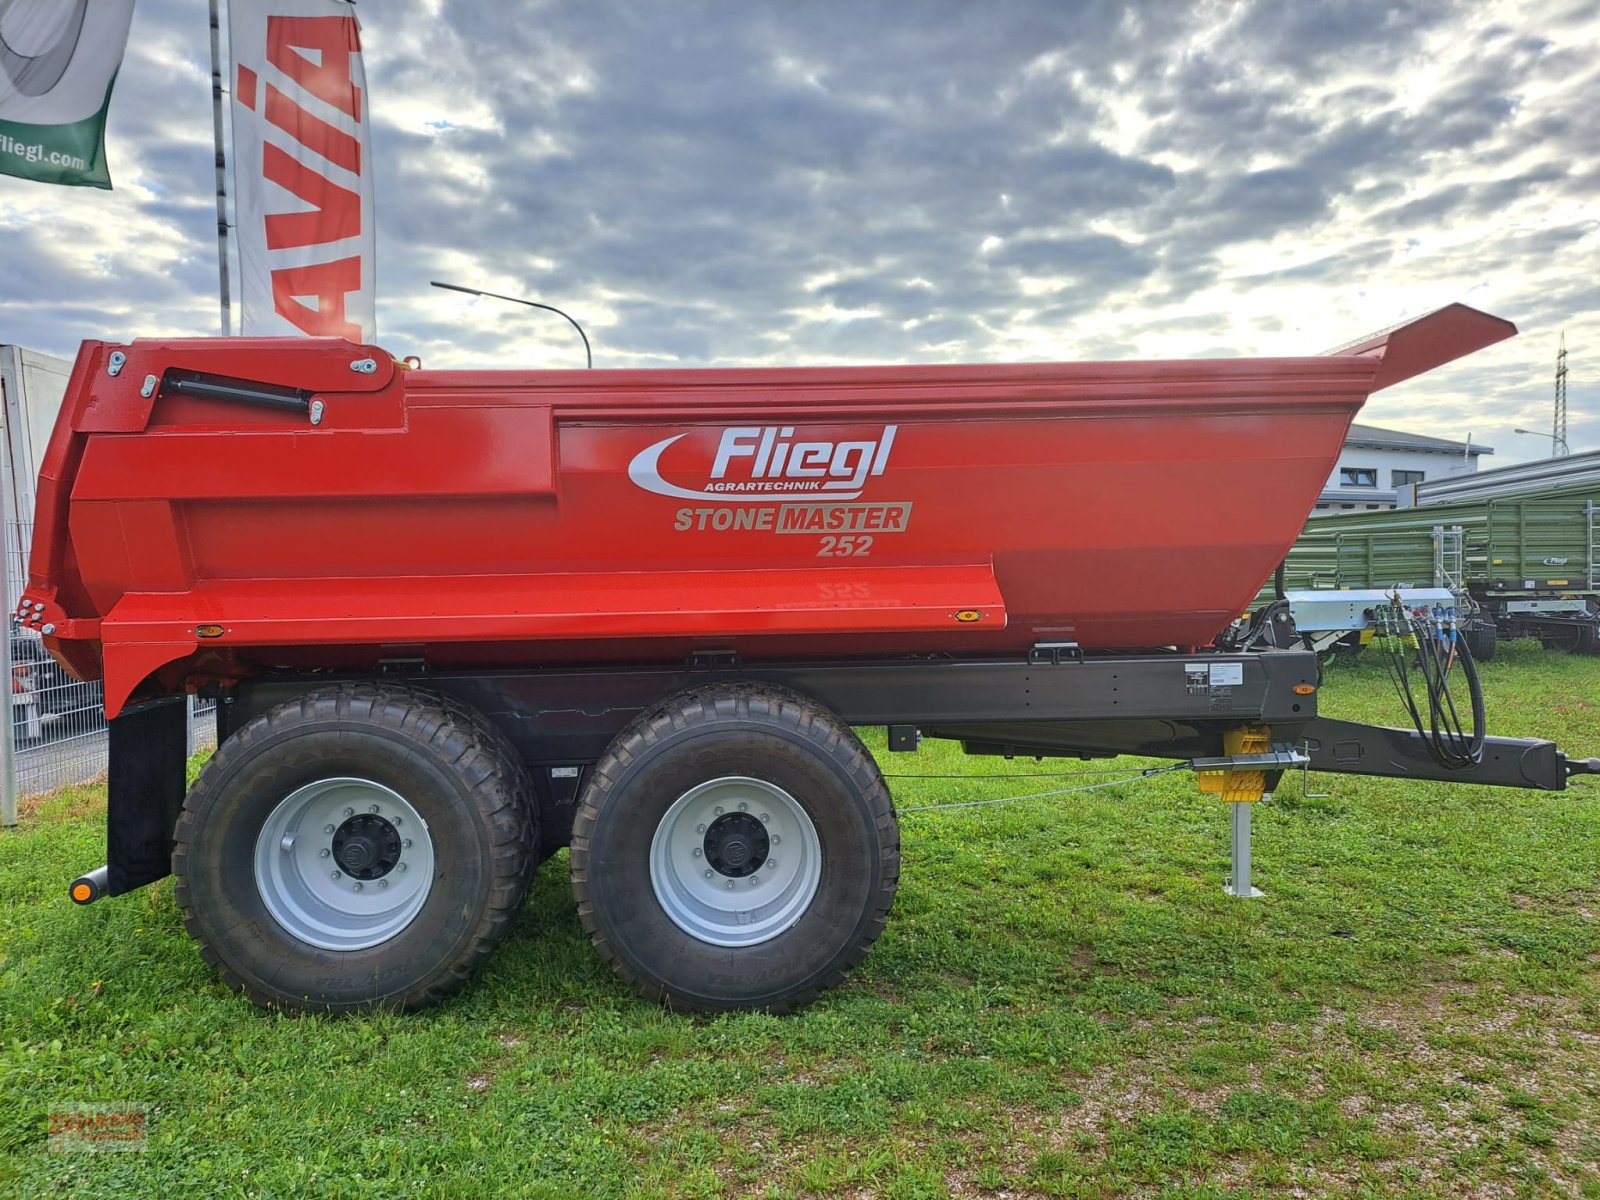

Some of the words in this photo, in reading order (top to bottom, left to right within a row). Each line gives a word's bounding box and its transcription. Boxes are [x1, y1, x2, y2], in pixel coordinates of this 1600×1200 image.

[236, 16, 362, 345] AVIA
[710, 425, 898, 490] Fliegl
[704, 481, 820, 491] AGRARTECHNIK
[674, 507, 776, 531] STONE
[782, 507, 903, 529] MASTER
[816, 535, 874, 557] 252
